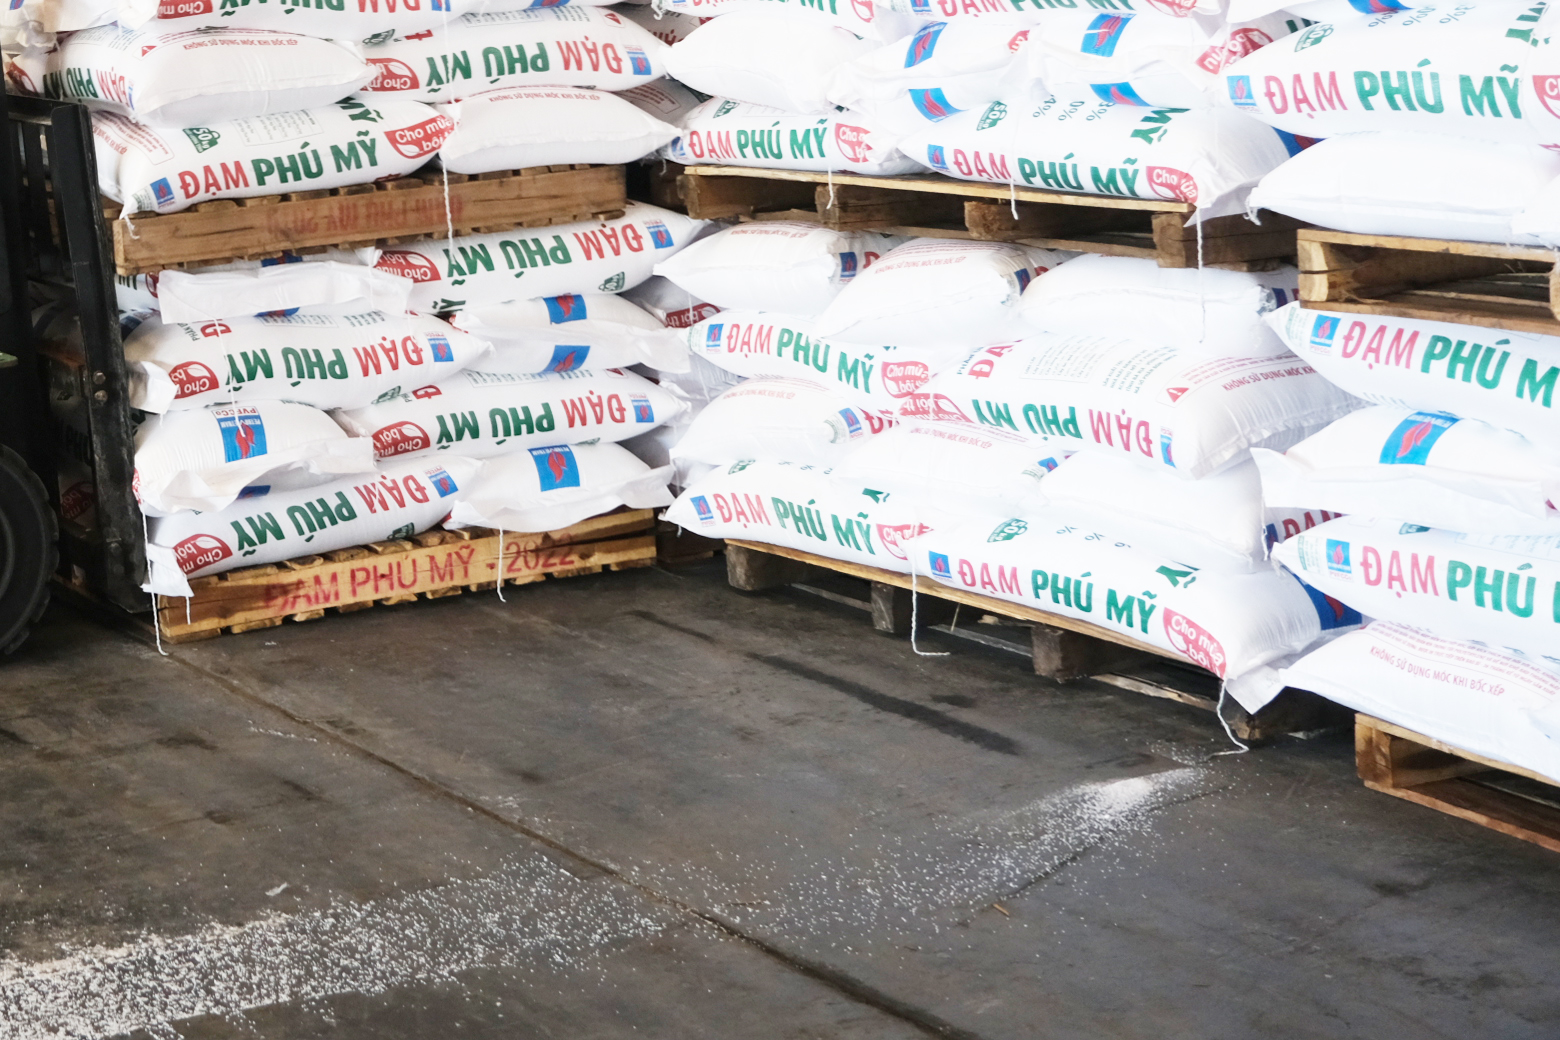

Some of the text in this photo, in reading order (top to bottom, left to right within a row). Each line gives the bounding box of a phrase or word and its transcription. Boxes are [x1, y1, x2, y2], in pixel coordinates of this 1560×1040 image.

[427, 36, 623, 103] ĐẠM PHÚ MỸ
[1265, 58, 1522, 121] ĐẠM PHÚ MỸ
[178, 131, 378, 199] ĐẠM PHÚ MỸ
[954, 149, 1139, 198] ĐẠM PHÚ MỸ
[444, 224, 644, 286] ĐẠM PHÚ MỸ
[226, 331, 424, 396] ĐẠM PHÚ MỸ
[436, 390, 626, 449] ĐẠM PHÚ MỸ
[231, 475, 430, 555] ĐẠM PHÚ MỸ
[713, 493, 876, 555] ĐẠM PHÚ MỸ
[350, 555, 418, 597] PHÚ
[430, 545, 474, 584] MỸ
[959, 559, 1157, 639] ĐẠM PHÚ MỸ
[1361, 547, 1537, 618] ĐẠM PHÚ
[1171, 615, 1196, 640] Cho
[1370, 646, 1395, 665] KHÔNG
[1453, 675, 1468, 687] KHI
